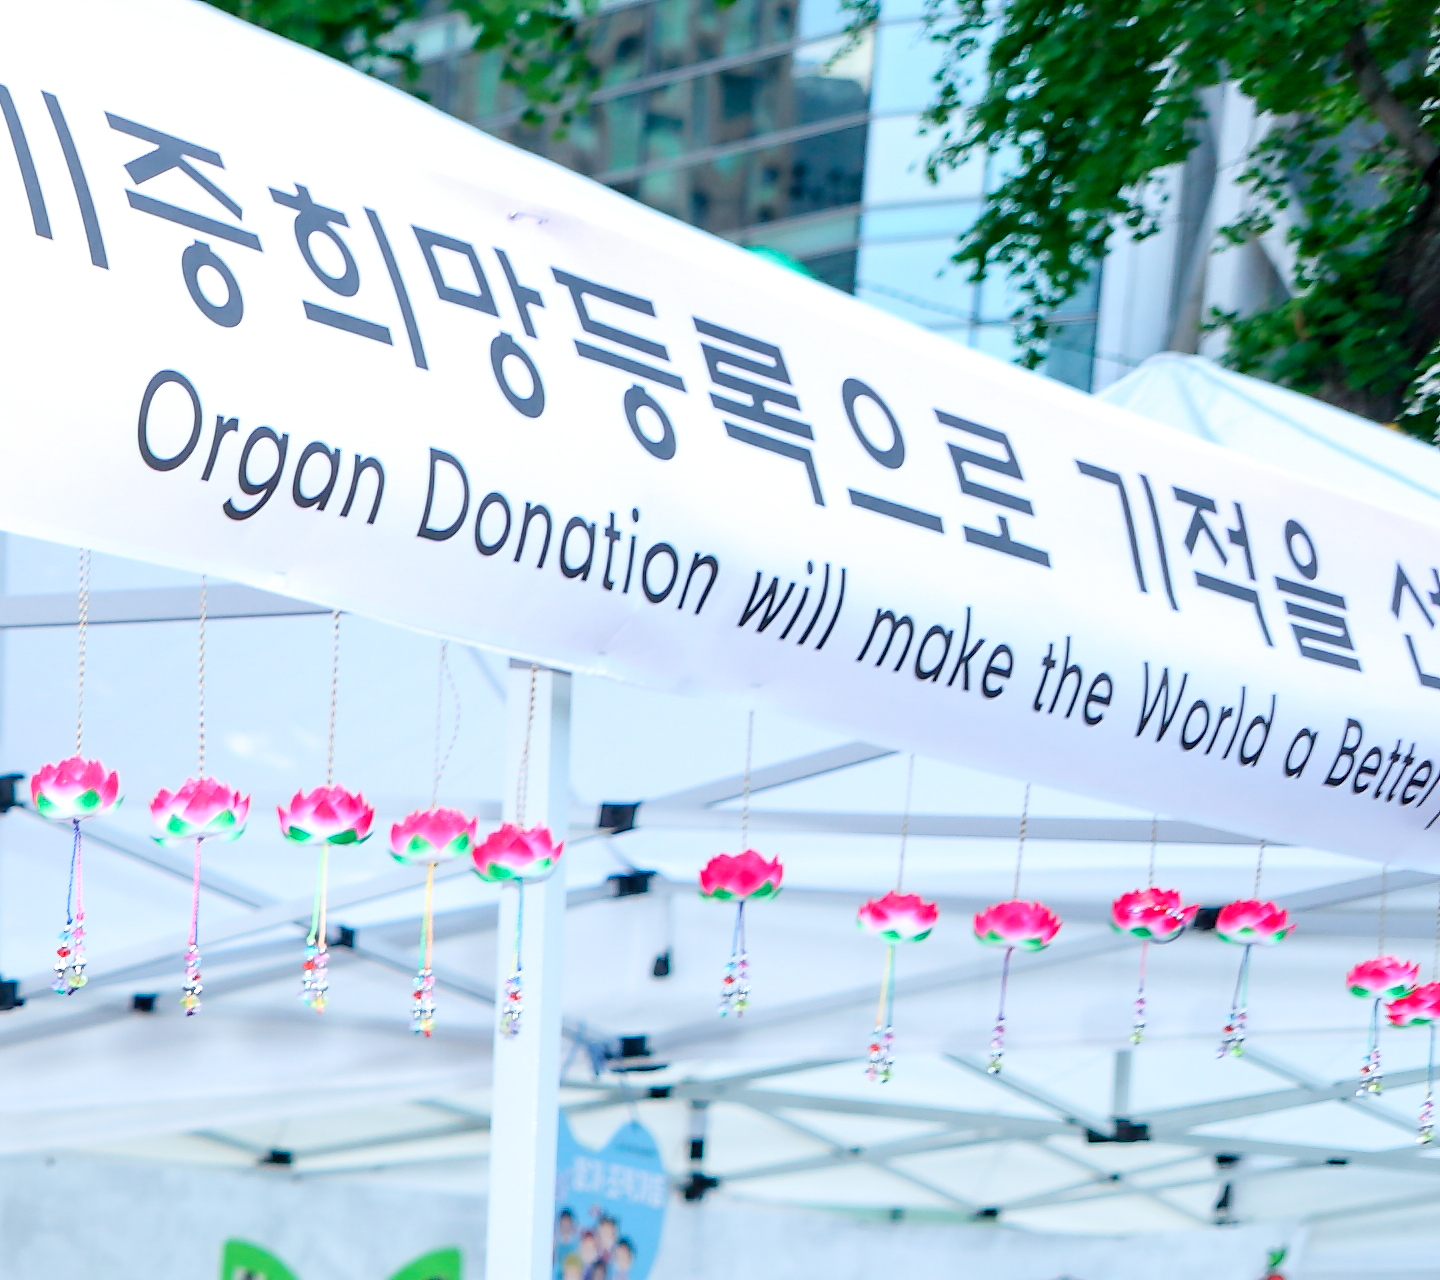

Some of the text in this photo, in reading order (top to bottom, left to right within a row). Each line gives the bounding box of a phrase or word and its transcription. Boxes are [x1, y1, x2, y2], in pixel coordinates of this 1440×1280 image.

[137, 369, 386, 521] Organ
[417, 447, 719, 604] Donation
[735, 562, 849, 651] will
[857, 606, 1015, 699] make
[1032, 635, 1113, 727] the
[1133, 661, 1278, 767] World
[1283, 727, 1318, 780] a
[1076, 459, 1363, 672] 기적을
